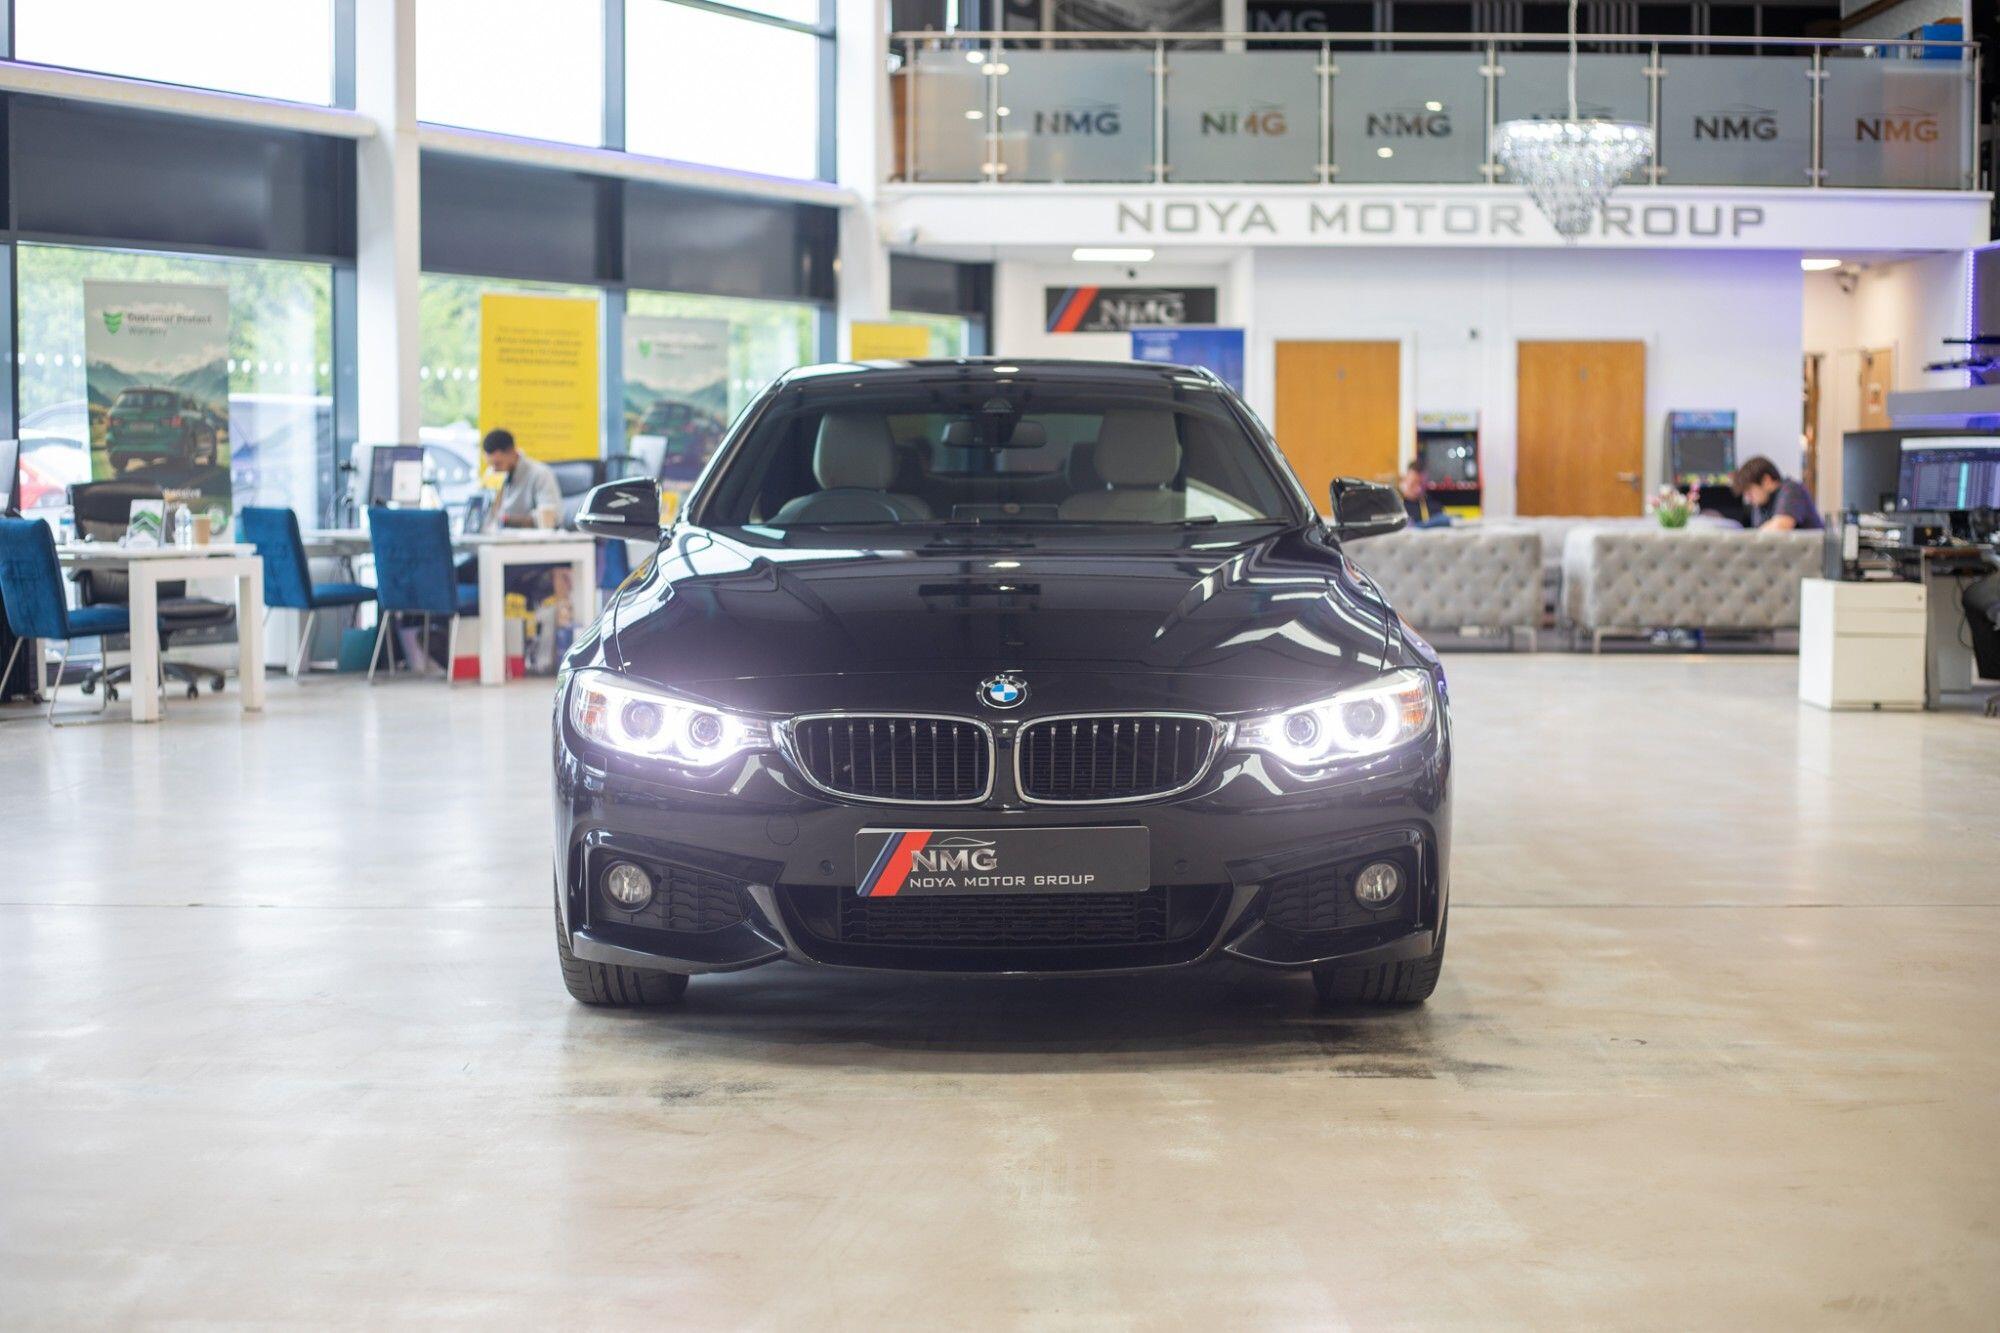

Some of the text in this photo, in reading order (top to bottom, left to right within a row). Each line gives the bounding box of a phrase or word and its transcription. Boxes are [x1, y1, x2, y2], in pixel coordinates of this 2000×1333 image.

[1247, 9, 1328, 32] MG
[1034, 110, 1121, 136] NMG
[1366, 112, 1452, 138] NMG
[1694, 115, 1779, 141] NMG
[1855, 117, 1940, 143] NMG
[1117, 202, 1277, 233] NOYA
[1309, 203, 1524, 235] MOTOR
[1099, 300, 1185, 327] NMG
[910, 849, 998, 872] NMG
[910, 874, 1095, 888] NOYA MOTOR GROUP
